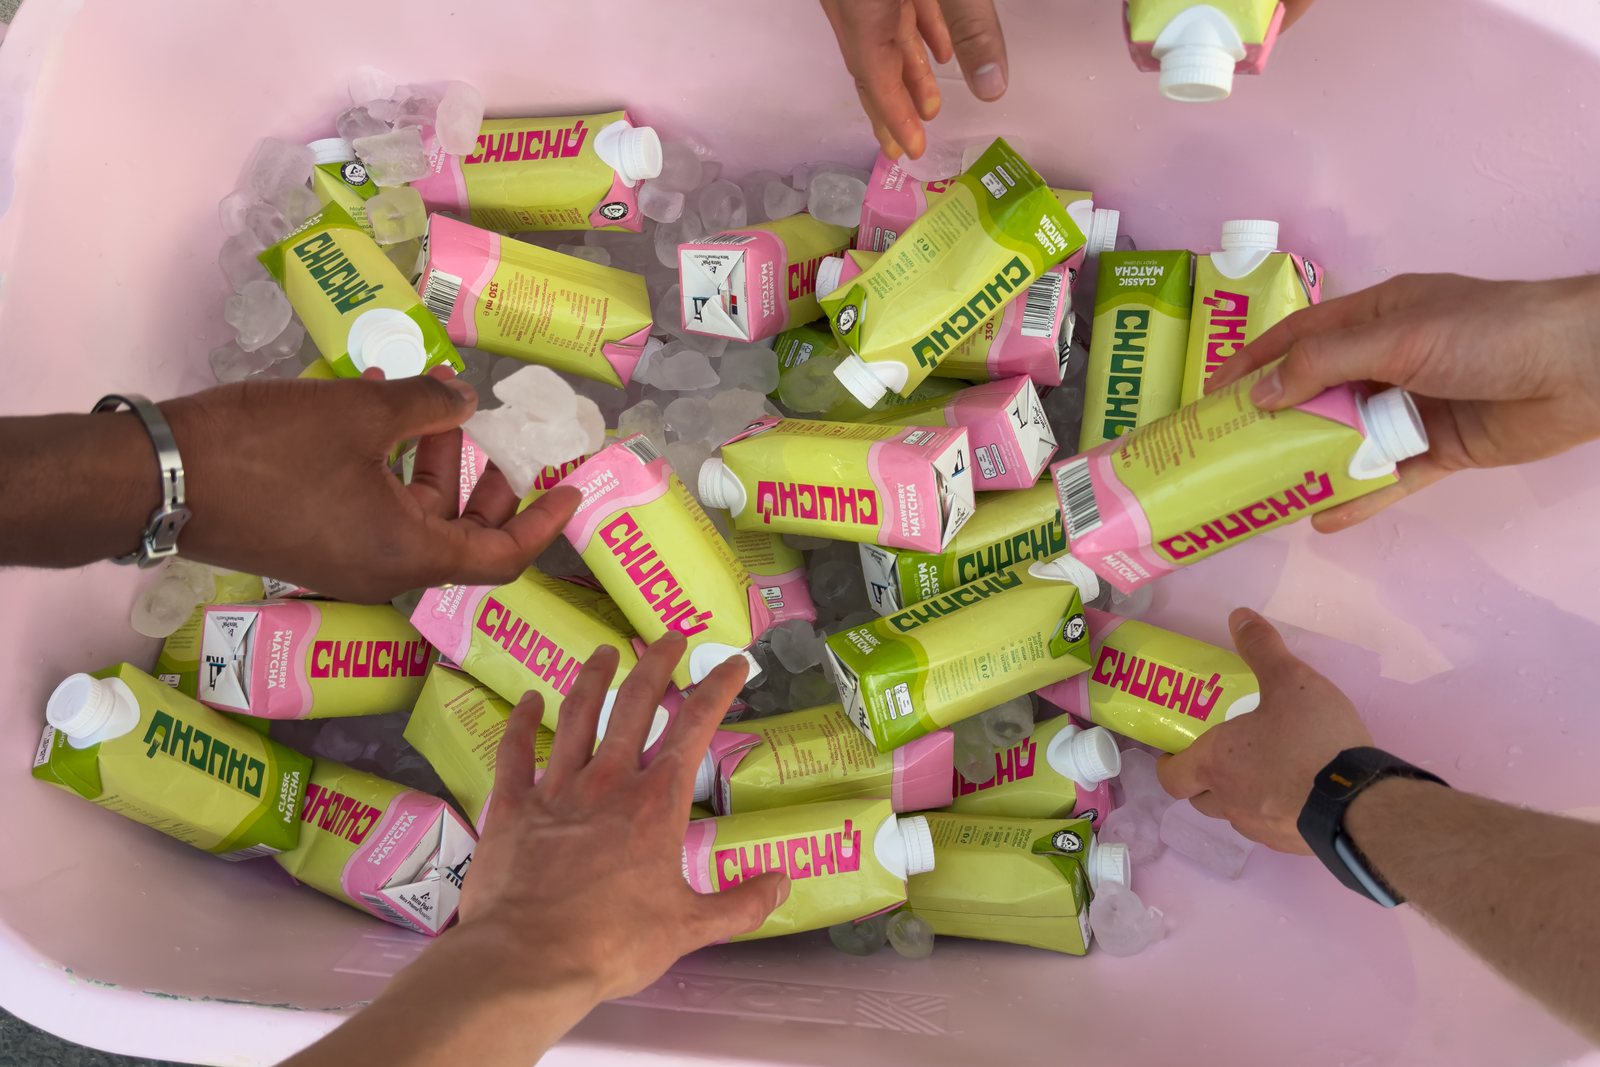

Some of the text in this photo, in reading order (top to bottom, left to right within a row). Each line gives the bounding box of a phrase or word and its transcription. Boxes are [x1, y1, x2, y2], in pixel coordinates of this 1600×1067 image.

[464, 120, 588, 164] CHUCHU
[1034, 228, 1057, 256] CLASSIC
[1039, 214, 1069, 252] MATCHA
[293, 232, 384, 315] CHUCHU
[489, 281, 498, 299] 330
[760, 263, 770, 319] MATCHA
[1114, 266, 1164, 277] MATCHA
[1118, 277, 1157, 287] CLASSIC
[485, 299, 493, 311] ml
[911, 256, 1032, 369] CHUCHU
[985, 321, 994, 341] 330
[1102, 310, 1150, 440] CHUCHU
[467, 445, 478, 488] STRAWBE
[1120, 448, 1131, 461] ml
[574, 478, 620, 516] STRAWBERR
[581, 468, 615, 498] MATC
[757, 480, 879, 526] CHUCHU
[897, 482, 910, 537] STRAWBERRY
[906, 484, 921, 537] MATCHA
[1158, 470, 1335, 560] CHUCHU
[958, 509, 1069, 586] CHUCHU
[1102, 554, 1141, 584] MATCHA
[1114, 550, 1153, 579] STRAWBERRY
[598, 512, 715, 638] CHUCHU
[918, 562, 932, 600] MATC
[929, 565, 939, 597] CLASS
[436, 585, 458, 613] TCHA
[447, 584, 467, 620] AWBERRY
[889, 567, 1024, 633] CHUCHU
[278, 629, 293, 689] STRAWBERRY
[312, 637, 433, 678] CHUCHU
[846, 630, 874, 655] MATCHA
[859, 628, 881, 647] CLASSIC
[267, 631, 284, 689] MATCHA
[1091, 645, 1224, 721] CHUCHU
[143, 709, 266, 798] CHUCHU
[278, 772, 291, 812] CLASSIC
[283, 771, 300, 824] MATCHA
[301, 783, 382, 845] CHUCHU
[367, 810, 409, 863] STRAWBERRY
[373, 814, 418, 865] MATCHA
[715, 819, 861, 891] CHUCHU
